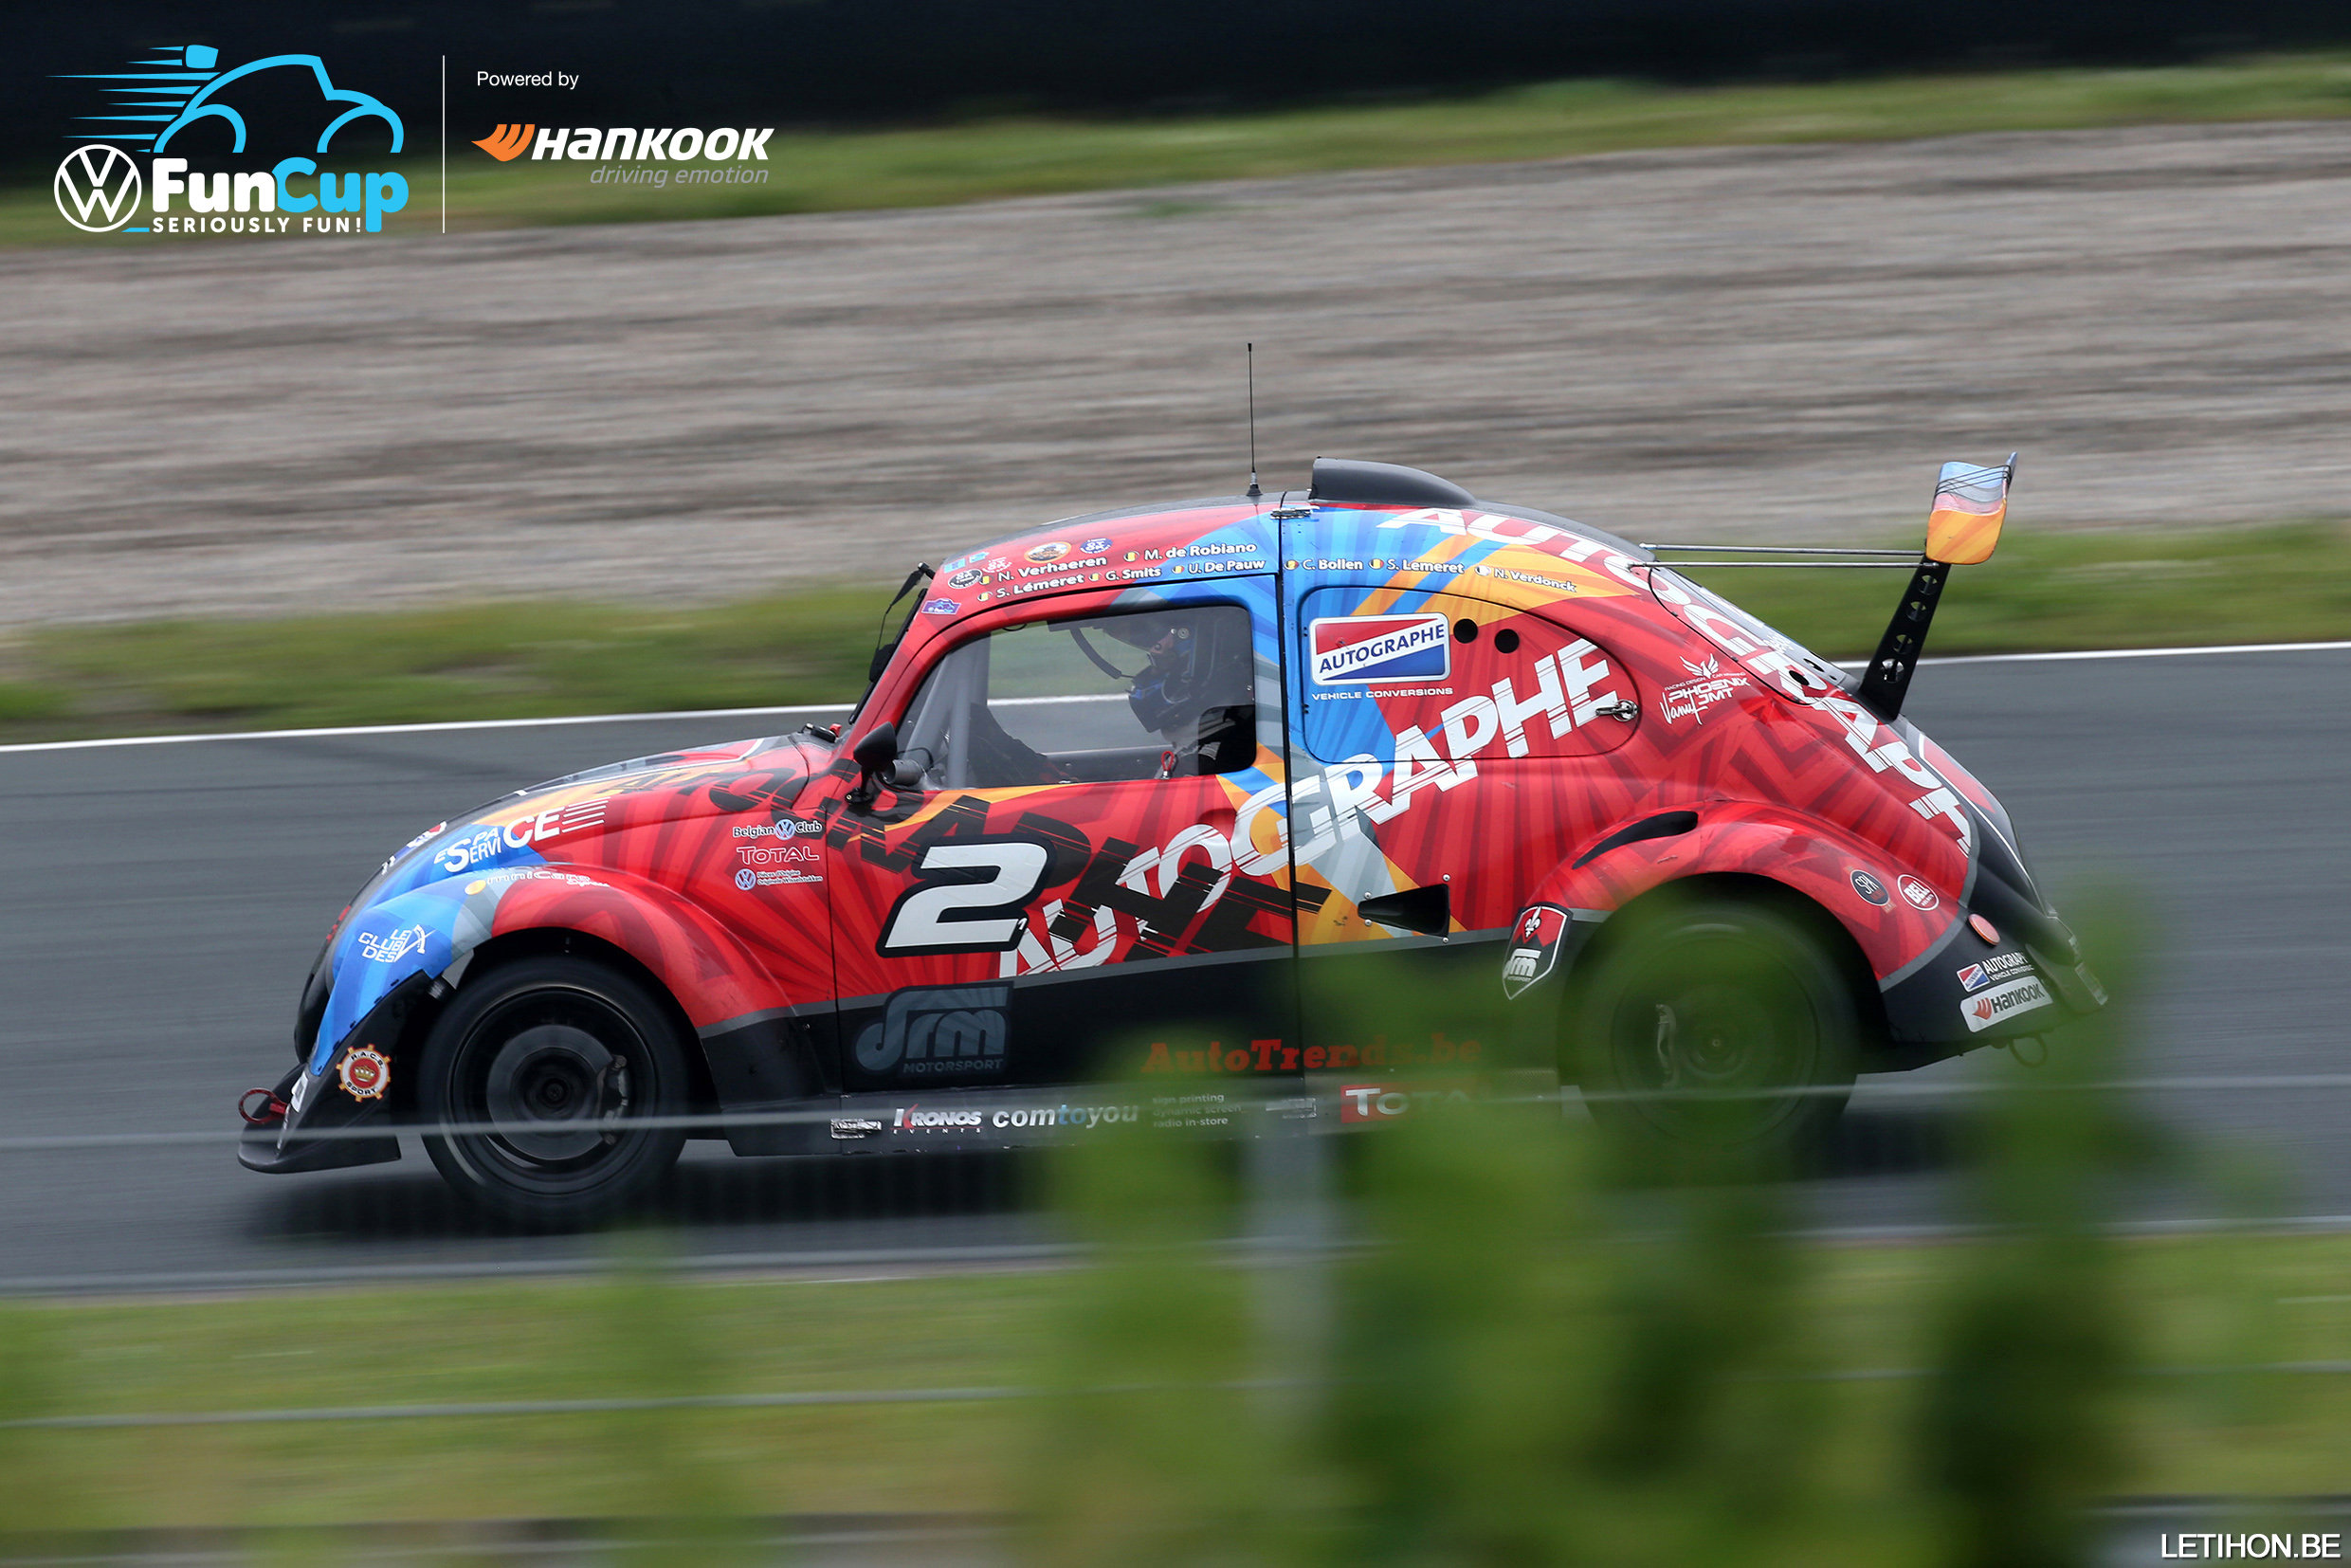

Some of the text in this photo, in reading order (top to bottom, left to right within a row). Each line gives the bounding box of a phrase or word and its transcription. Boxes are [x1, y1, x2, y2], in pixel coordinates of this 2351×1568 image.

[1145, 543, 1257, 561] M. de Robiano
[998, 571, 1015, 582] N.
[1018, 556, 1107, 578] Verhaeren
[1189, 559, 1266, 574] U. De Pauw
[1302, 558, 1363, 570] C. Bollen
[1387, 559, 1464, 574] S. Lemeret
[1105, 566, 1162, 581] G. Smits
[1494, 568, 1576, 593] N. Verdonck
[995, 586, 1011, 598] S.
[1319, 624, 1445, 673] AUTOGRAPHE
[1312, 687, 1454, 701] VEHICLE CONVERSIONS
[1668, 677, 1750, 702] PHOENIX
[733, 825, 775, 839] Belgian
[795, 820, 822, 833] Club
[736, 846, 820, 865] TOTAL
[884, 842, 1049, 950] 2
[358, 932, 404, 951] CLUB
[390, 929, 411, 940] LE
[902, 1058, 1003, 1075] MOTORSPORT
[1179, 1093, 1225, 1104] printing
[893, 1104, 983, 1128] KRONOS
[992, 1103, 1138, 1129] comtoyou
[1205, 1104, 1241, 1115] screen
[1185, 1117, 1229, 1127] in-store
